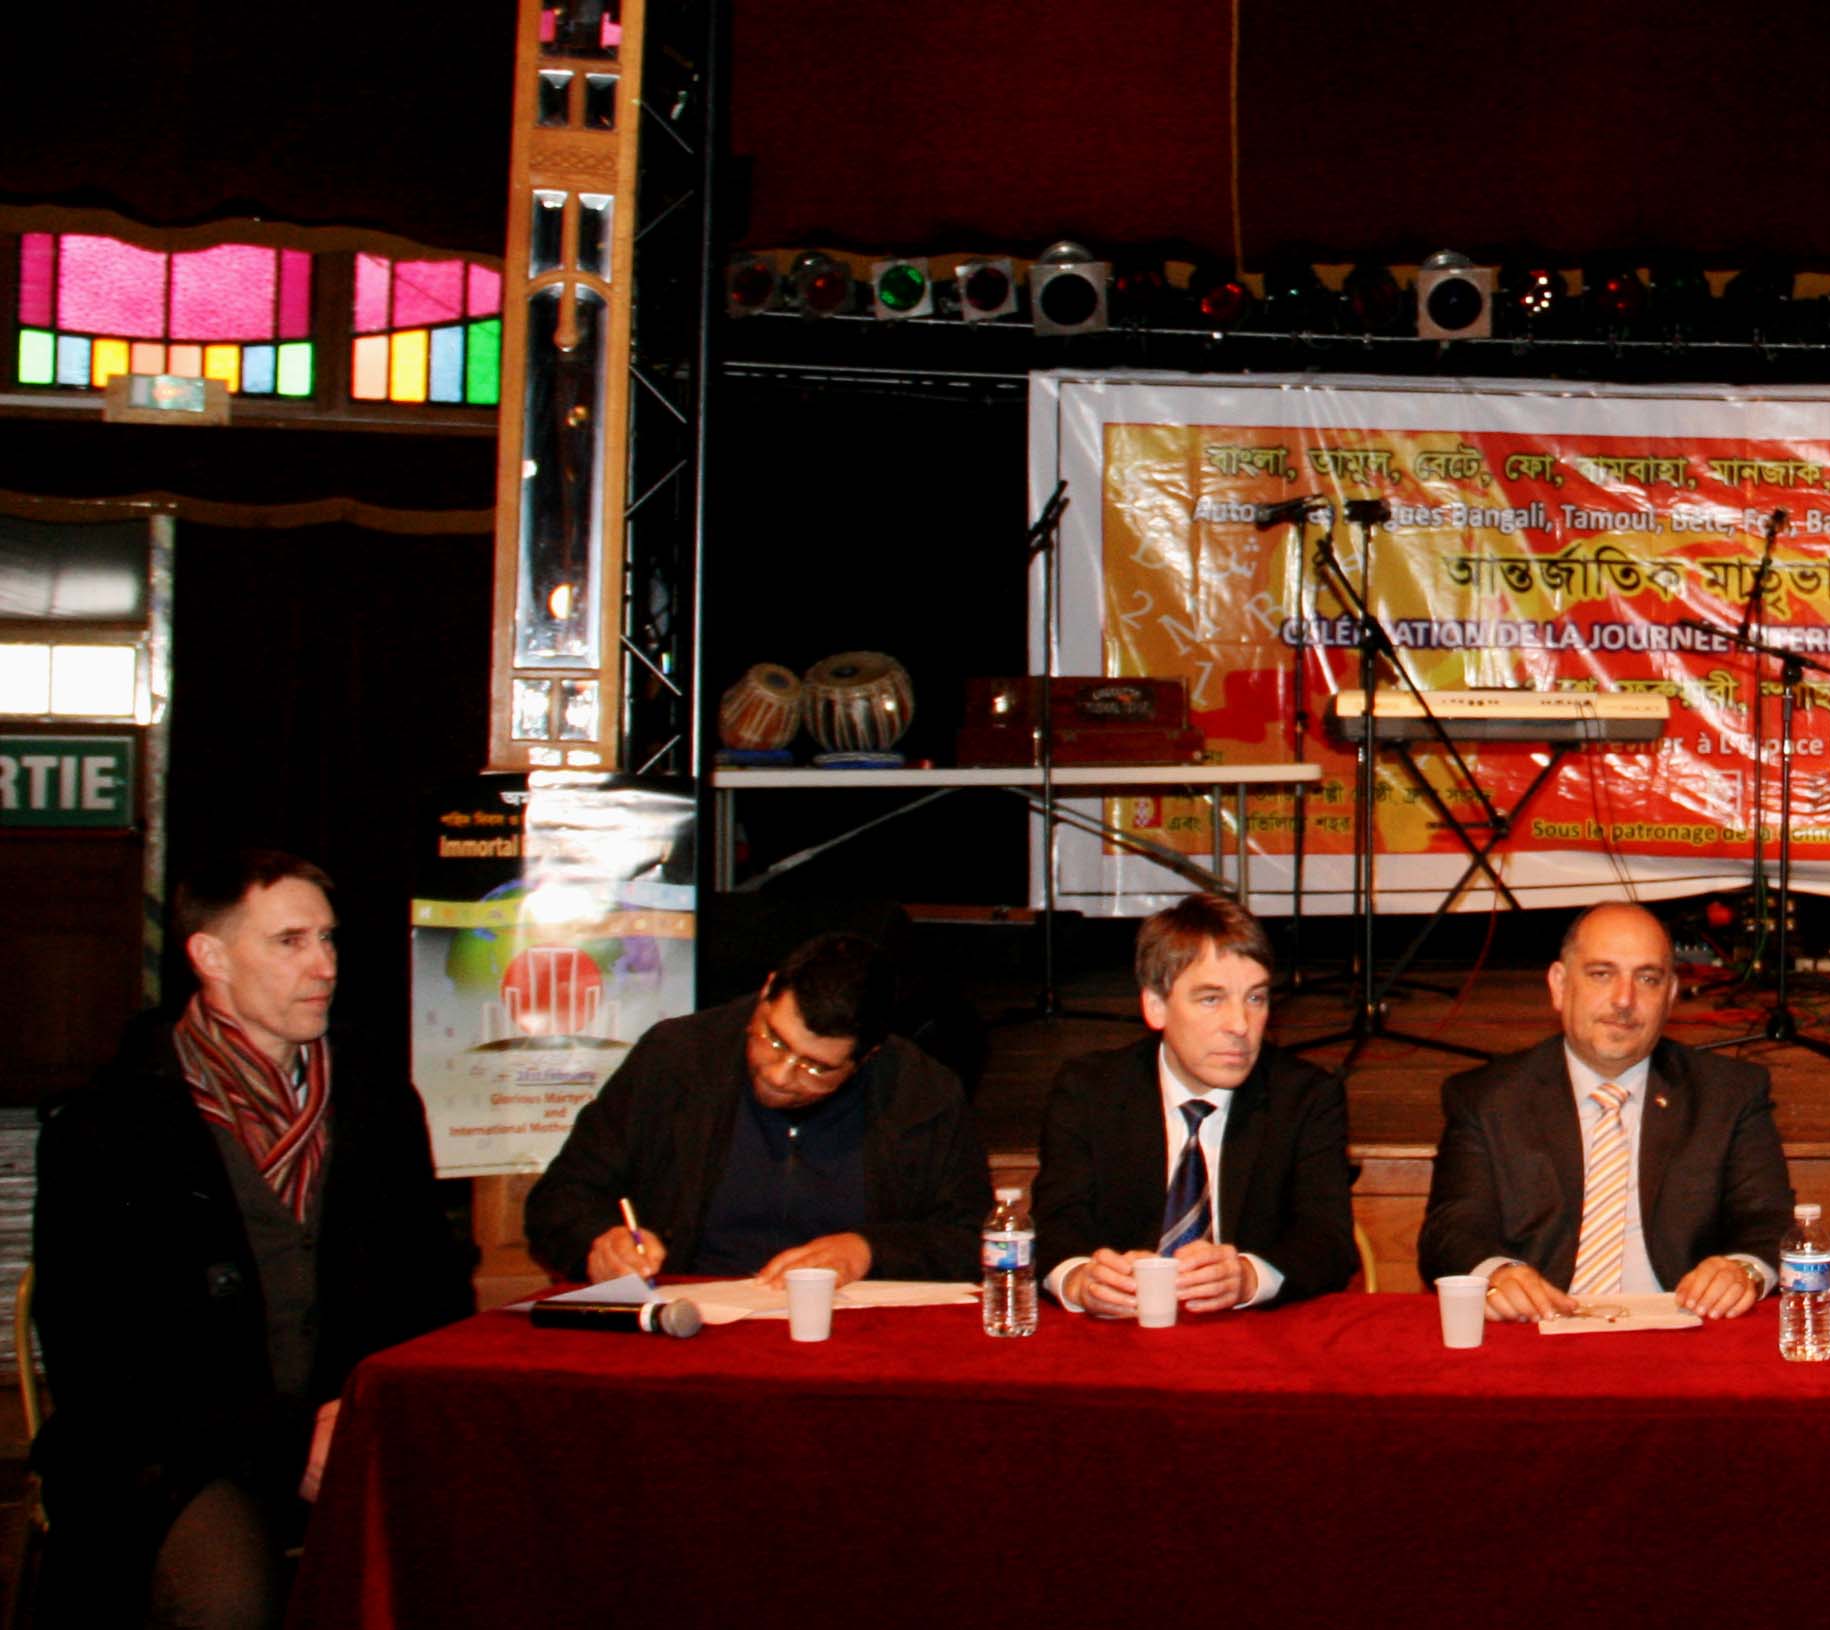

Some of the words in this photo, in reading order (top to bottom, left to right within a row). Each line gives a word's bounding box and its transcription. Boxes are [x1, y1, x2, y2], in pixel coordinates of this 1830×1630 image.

[1452, 503, 1552, 533] Bangali,
[1561, 504, 1662, 535] Tamoul,
[1503, 622, 1540, 647] DE
[1545, 623, 1580, 648] LA
[1697, 731, 1712, 754] à
[1533, 821, 1581, 840] Sous
[1611, 822, 1716, 845] patronage
[439, 835, 518, 858] Immortal
